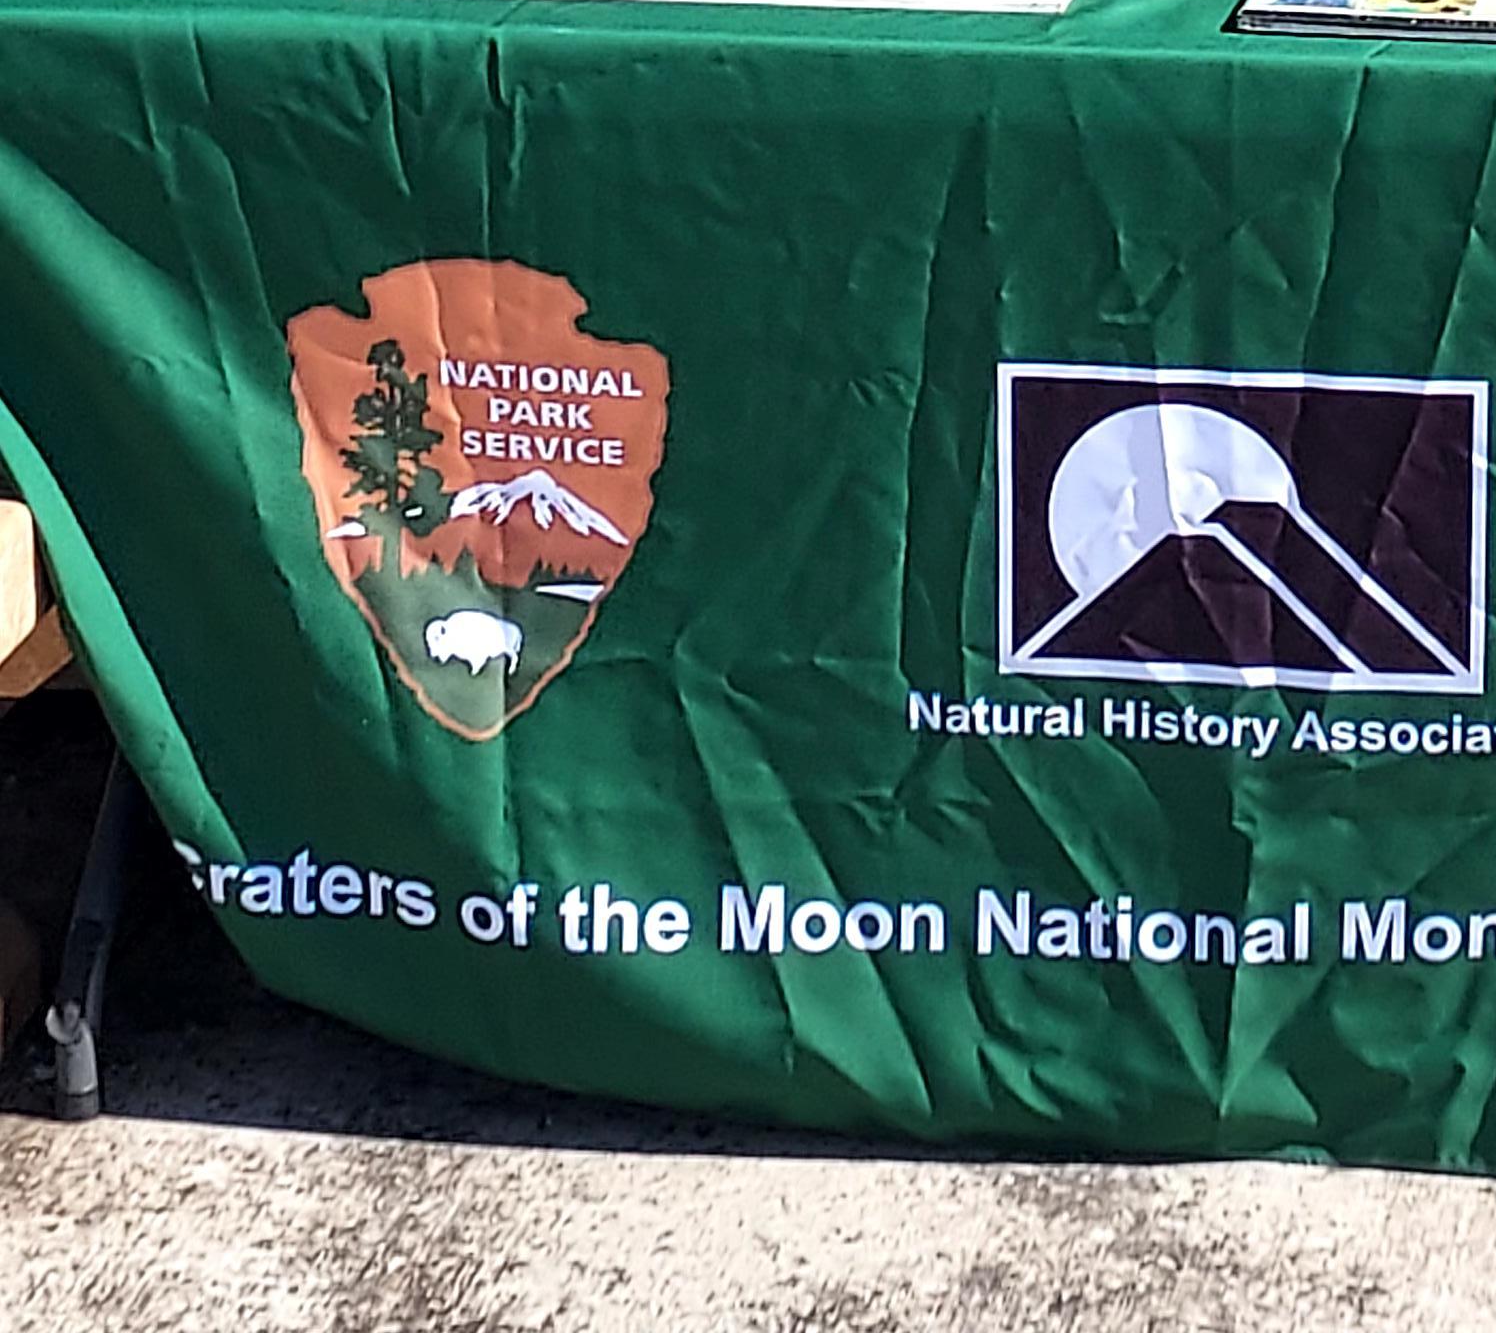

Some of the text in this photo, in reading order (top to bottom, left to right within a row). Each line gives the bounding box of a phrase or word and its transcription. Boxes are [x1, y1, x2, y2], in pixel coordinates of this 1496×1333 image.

[439, 358, 643, 398] NATIONAL
[488, 396, 593, 431] PARK
[462, 431, 624, 466] SERVICE
[907, 690, 1084, 739] Natural
[1102, 699, 1280, 758] History
[460, 883, 538, 948] of
[559, 884, 691, 954] the
[719, 884, 946, 954] Moon
[976, 888, 1310, 965] National
